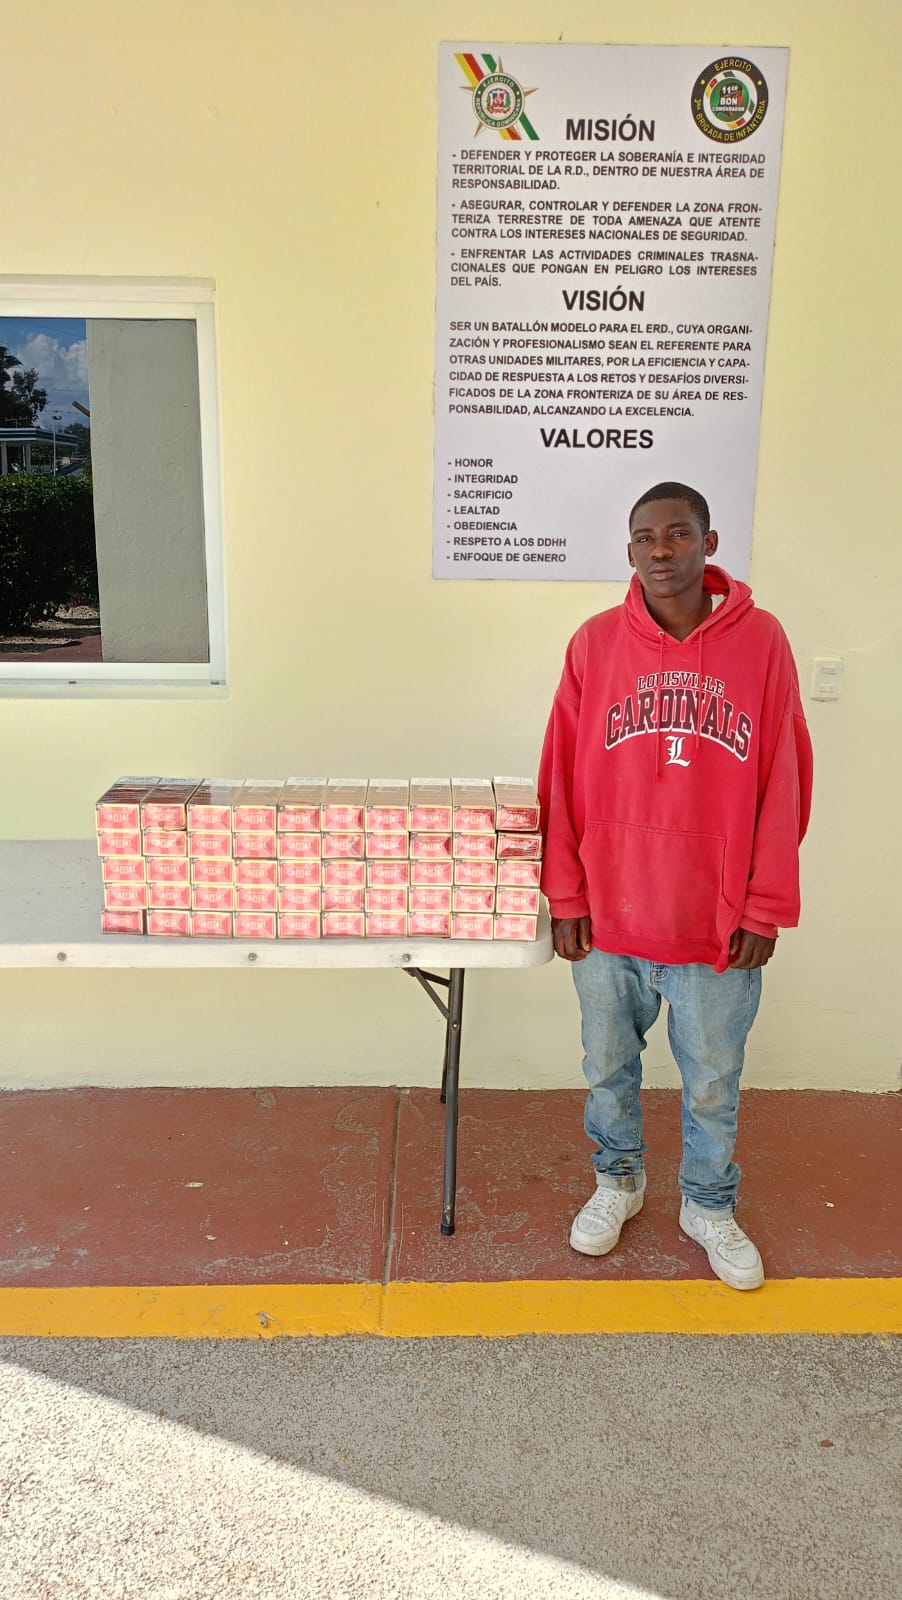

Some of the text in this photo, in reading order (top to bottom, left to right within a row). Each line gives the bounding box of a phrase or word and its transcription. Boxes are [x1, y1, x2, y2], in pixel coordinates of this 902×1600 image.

[714, 59, 752, 72] EJERCITO
[720, 97, 738, 106] BON
[695, 113, 723, 140] BRIGADA
[724, 133, 735, 141] DE
[736, 99, 766, 140] INFANTERIA
[566, 113, 655, 141] MISIÓN
[461, 150, 520, 160] DEFENDER
[524, 151, 532, 160] Y
[536, 151, 596, 161] PROTEGER
[601, 152, 615, 161] LA
[618, 150, 683, 163] SOBERANÍA
[687, 153, 694, 163] E
[698, 153, 765, 164] INTEGRIDAD
[452, 164, 765, 178] TERRITORIAL DE LA R.D., DENTRO DE NUESTRA ÁREA DE
[452, 178, 559, 190] RESPONSABILIDAD.
[460, 200, 524, 211] ASEGURAR,
[529, 201, 598, 211] CONTROLAR
[602, 201, 609, 211] Y
[613, 201, 672, 212] DEFENDER
[676, 202, 690, 212] LA
[693, 203, 724, 213] ZONA
[728, 203, 762, 213] FRON-
[452, 214, 760, 227] TERIZA TERRESTRE DE TODA AMENAZA QUE ATENTE
[452, 228, 747, 241] CONTRA LOS INTERESES NACIONALES DE SEGURIDAD.
[461, 249, 526, 259] ENFRENTAR
[533, 250, 553, 259] LAS
[559, 250, 631, 260] ACTIVIDADES
[638, 251, 704, 261] CRIMINALES
[710, 252, 758, 262] TRASNA-
[451, 263, 757, 276] CIONALES QUE PONGAN EN PELIGRO LOS INTERESES
[451, 275, 501, 286] DEL PAÍS.
[562, 285, 644, 311] VISIÓN
[450, 320, 752, 335] SER UN BATALLÓN MODELO PARA EL ERD., CUYA ORGANI-
[449, 336, 751, 351] ZACIÓN Y PROFESIONALISMO SEAN EL REFERENTE PARA
[449, 355, 750, 368] OTRAS UNIDADES MILITARES, POR LA EFICIENCIA Y CAPA-
[449, 371, 749, 384] CIDAD DE RESPUESTA A LOS RETOS Y DESAFÍOS DIVERSI-
[449, 388, 748, 400] FICADOS DE LA ZONA FRONTERIZA DE SU ÁREA DE RES-
[449, 404, 694, 416] PONSABILIDAD, ALCANZANDO LA EXCELENCIA.
[540, 428, 653, 449] VALORES
[455, 458, 493, 467] HONOR
[455, 474, 518, 484] INTEGRIDAD
[454, 490, 512, 499] SACRIFICIO
[454, 506, 500, 515] LEALTAD
[454, 521, 517, 531] OBEDIENCIA
[454, 537, 502, 546] RESPETO
[504, 537, 511, 546] A
[514, 537, 534, 546] LOS
[537, 538, 566, 547] DDHH
[454, 552, 503, 561] ENFOQUE
[506, 553, 520, 562] DE
[523, 553, 566, 562] GENERO
[605, 688, 753, 763] CARDINALS
[664, 735, 691, 767] L
